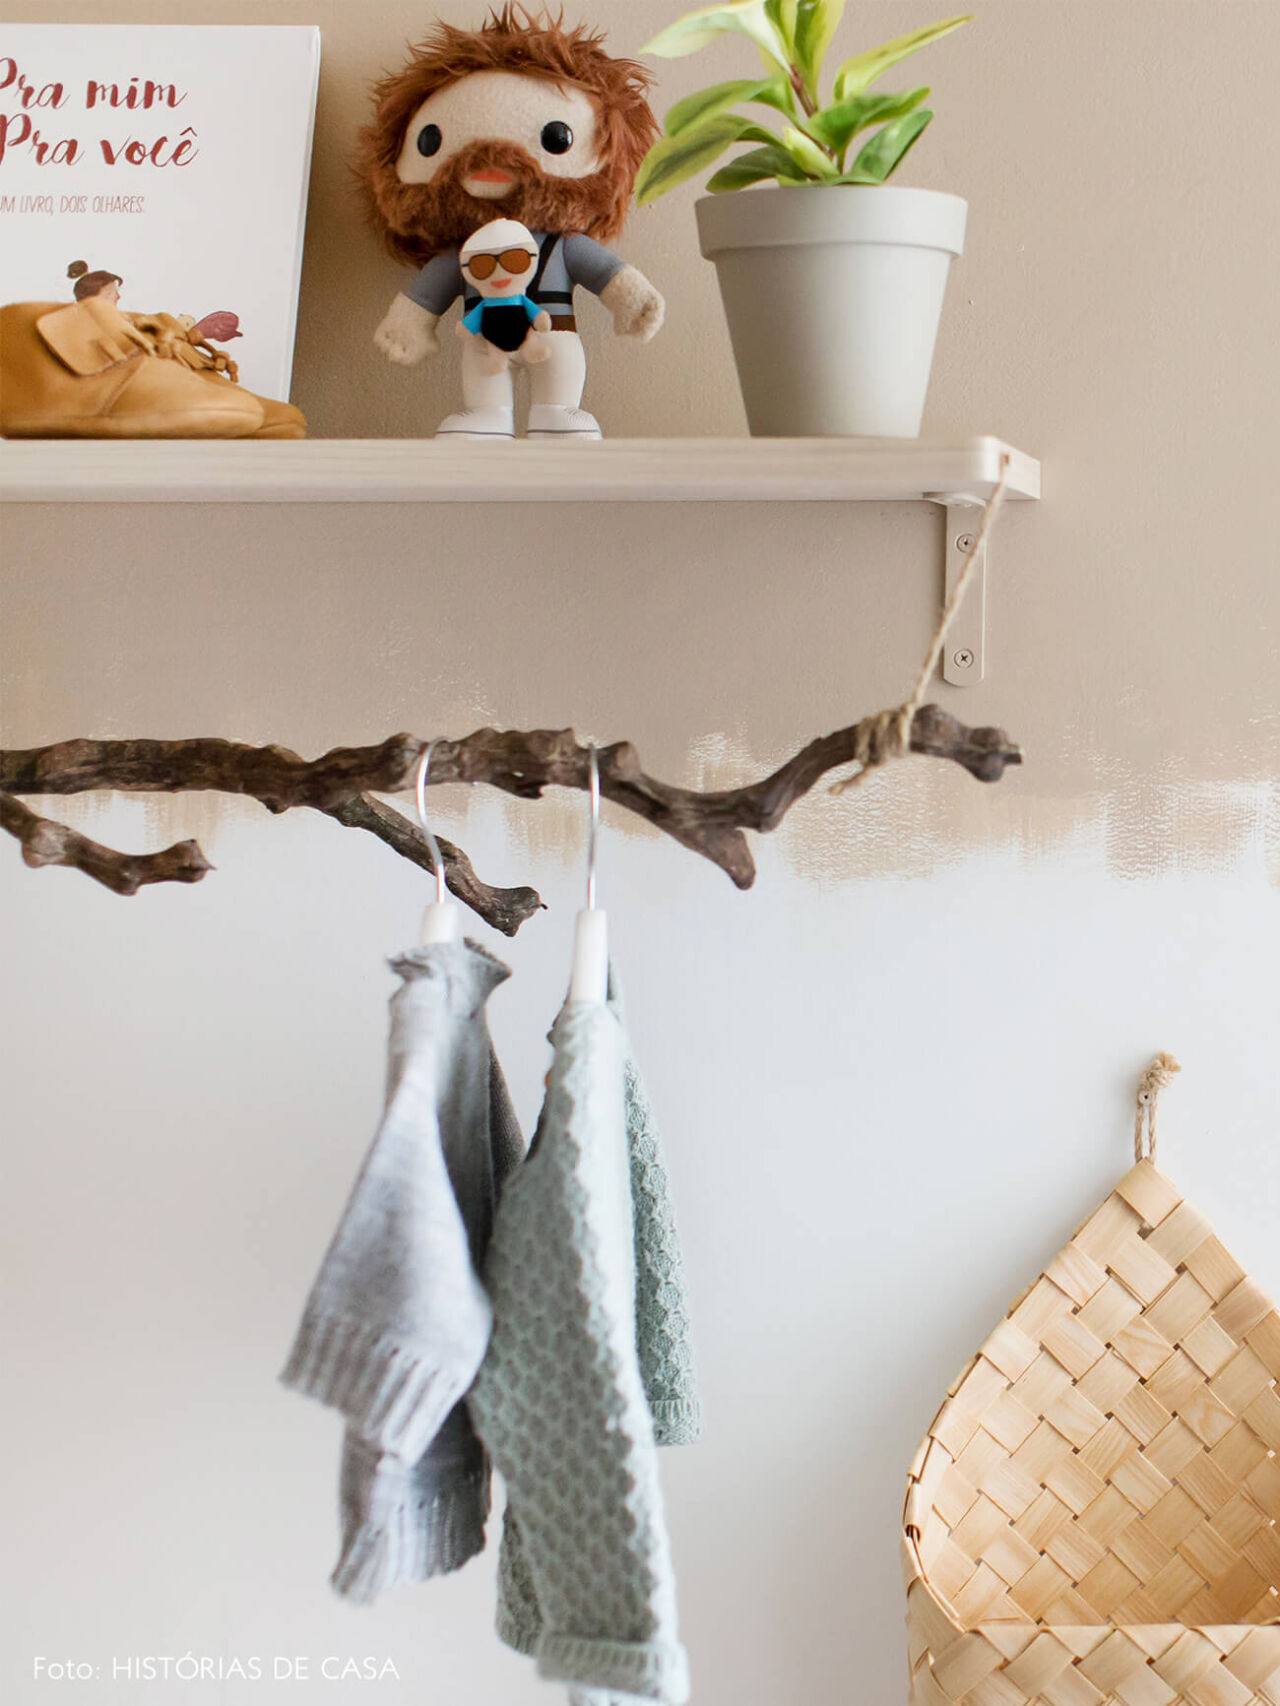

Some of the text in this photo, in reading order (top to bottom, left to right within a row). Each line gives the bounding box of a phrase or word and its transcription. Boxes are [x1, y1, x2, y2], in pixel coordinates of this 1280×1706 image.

[86, 77, 189, 110] mim
[0, 112, 199, 168] Pra você
[59, 195, 89, 214] DOIS
